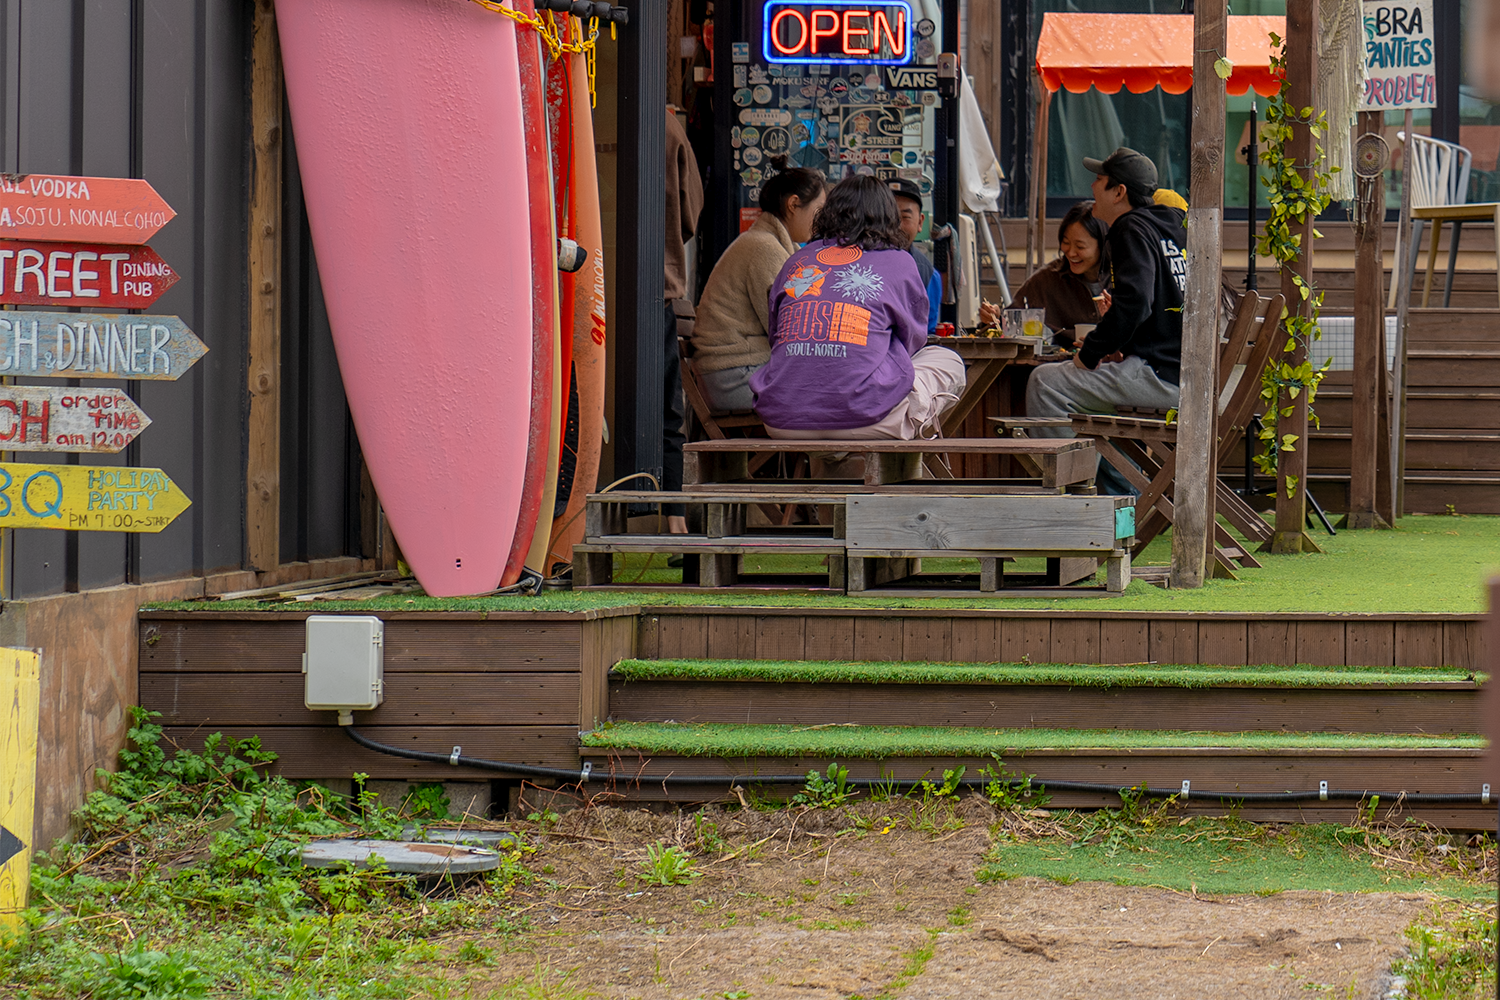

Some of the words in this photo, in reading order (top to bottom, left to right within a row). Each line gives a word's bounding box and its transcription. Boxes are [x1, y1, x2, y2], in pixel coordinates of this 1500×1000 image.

[771, 8, 904, 55] OPEN
[1376, 7, 1422, 37] BRA
[803, 77, 829, 85] SURF
[886, 67, 937, 88] VANS
[1364, 73, 1435, 106] PROBLEM
[123, 262, 171, 277] DINING
[124, 281, 152, 296] PUB
[57, 322, 171, 375] DINNER
[61, 394, 125, 408] order
[88, 470, 171, 491] HOLIDAY
[88, 491, 157, 510] PARTY
[69, 514, 88, 527] PM
